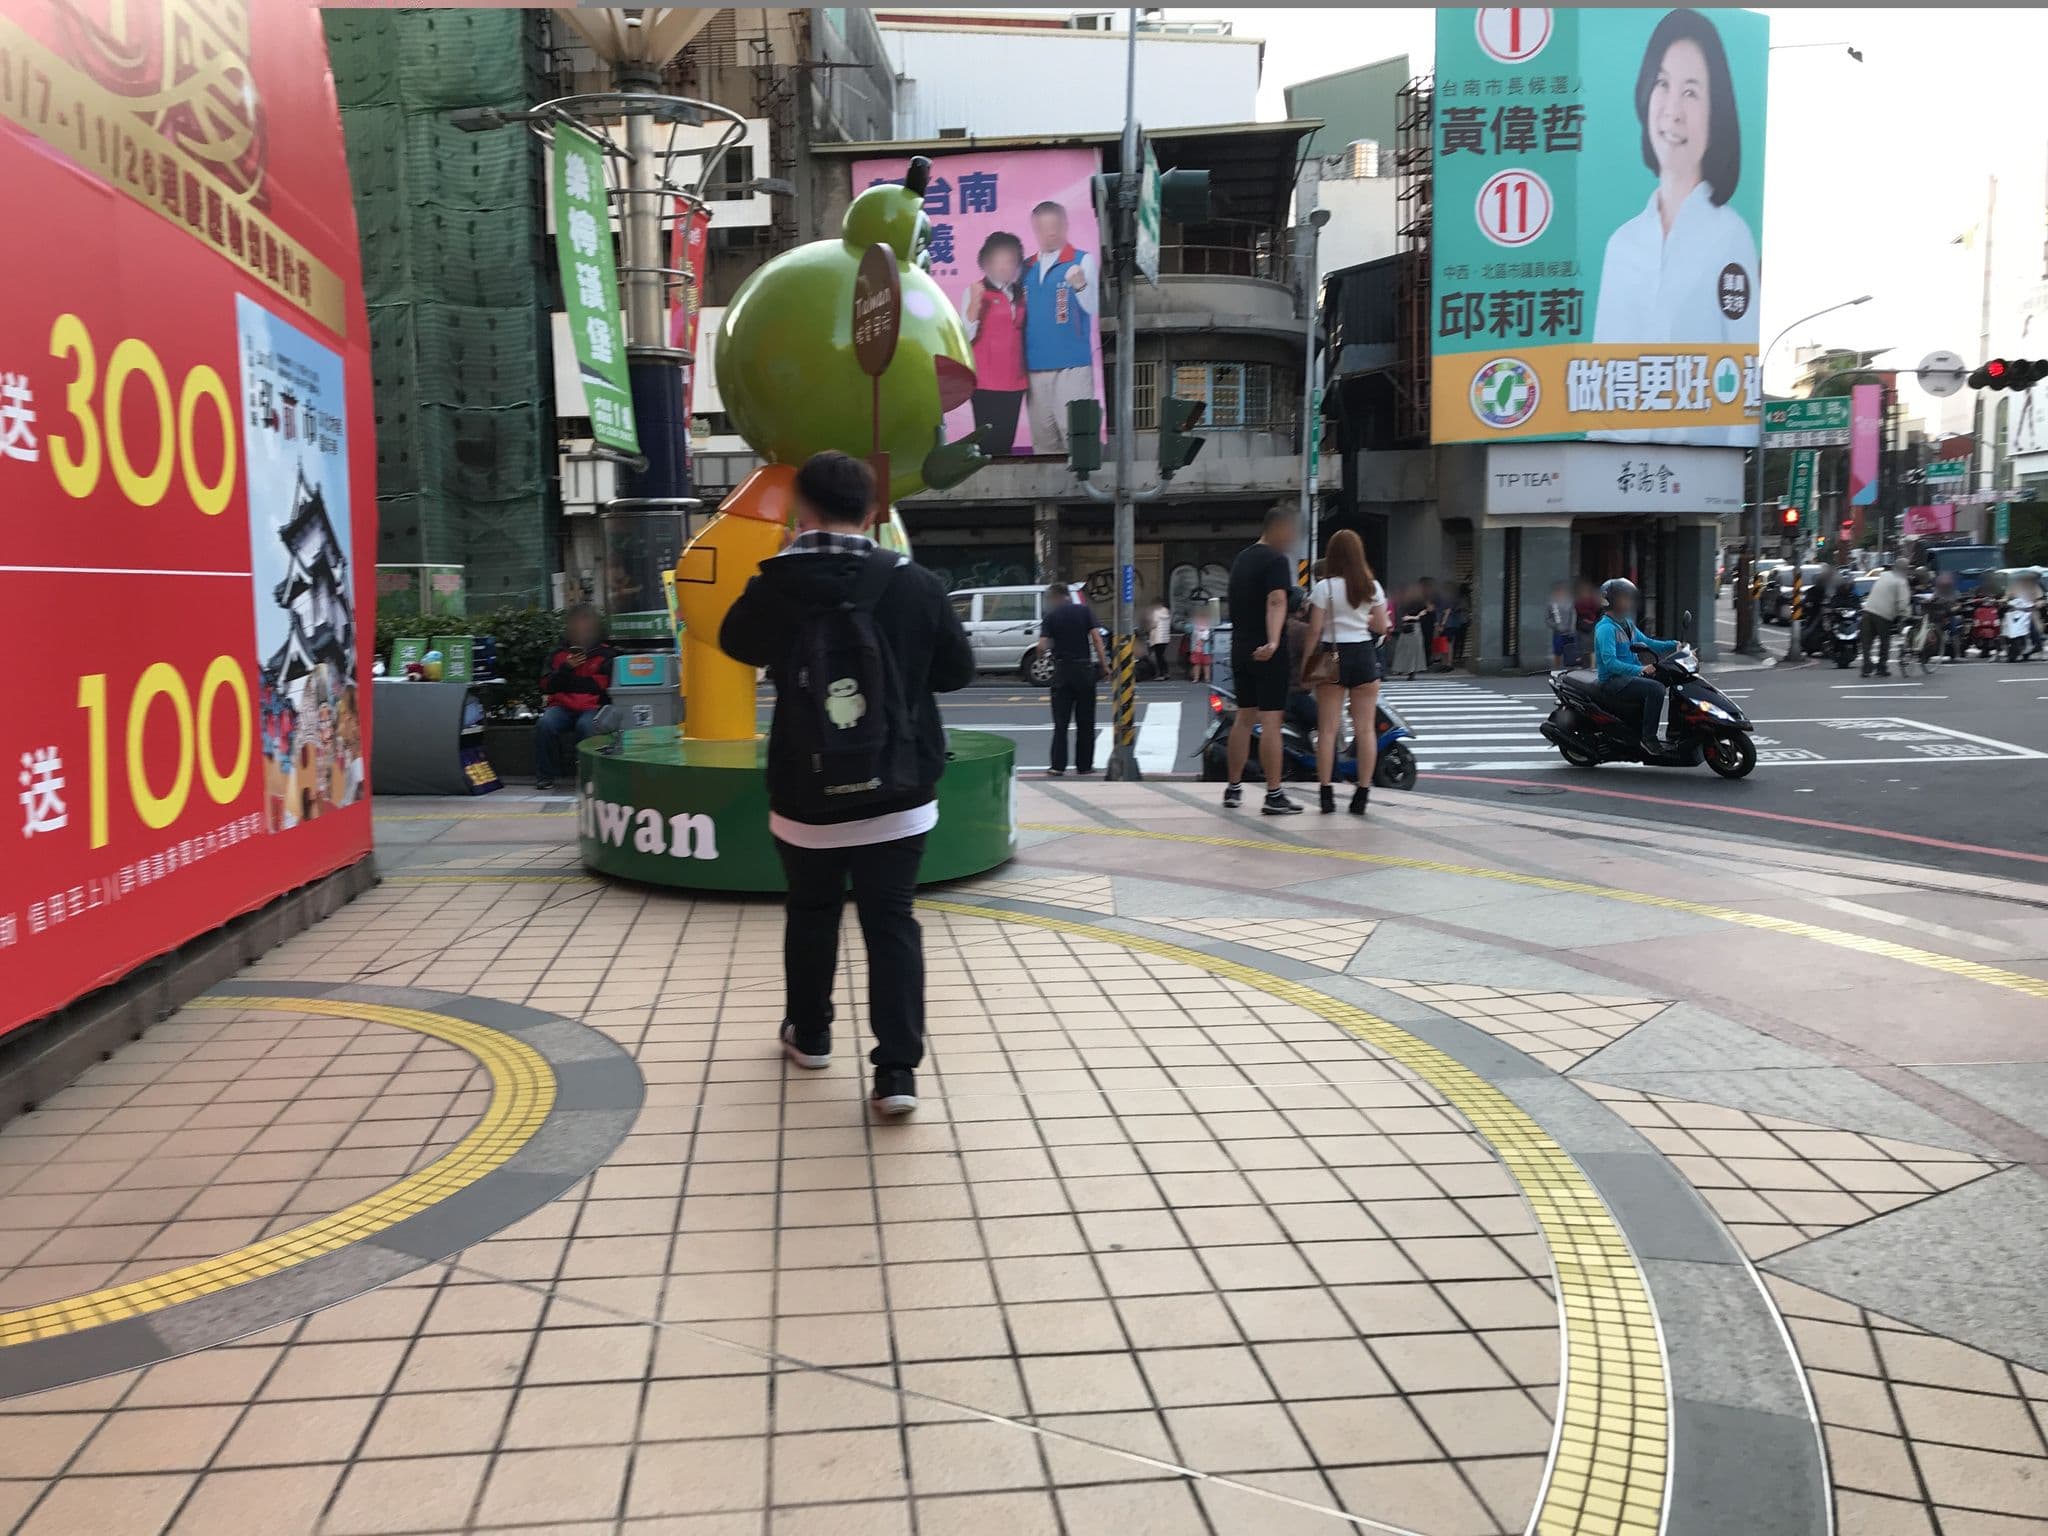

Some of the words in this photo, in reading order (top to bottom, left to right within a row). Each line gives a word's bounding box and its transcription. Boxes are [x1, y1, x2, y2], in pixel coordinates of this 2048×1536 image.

[1441, 75, 1586, 97] 台南市長候選人
[1440, 103, 1587, 157] 黃偉哲
[1495, 181, 1527, 233] 11
[1439, 287, 1584, 340] 邱莉莉
[48, 313, 237, 516] 300
[1495, 473, 1519, 488] TP
[1523, 472, 1552, 488] TEA
[19, 746, 68, 838] 送
[78, 655, 252, 849] 100
